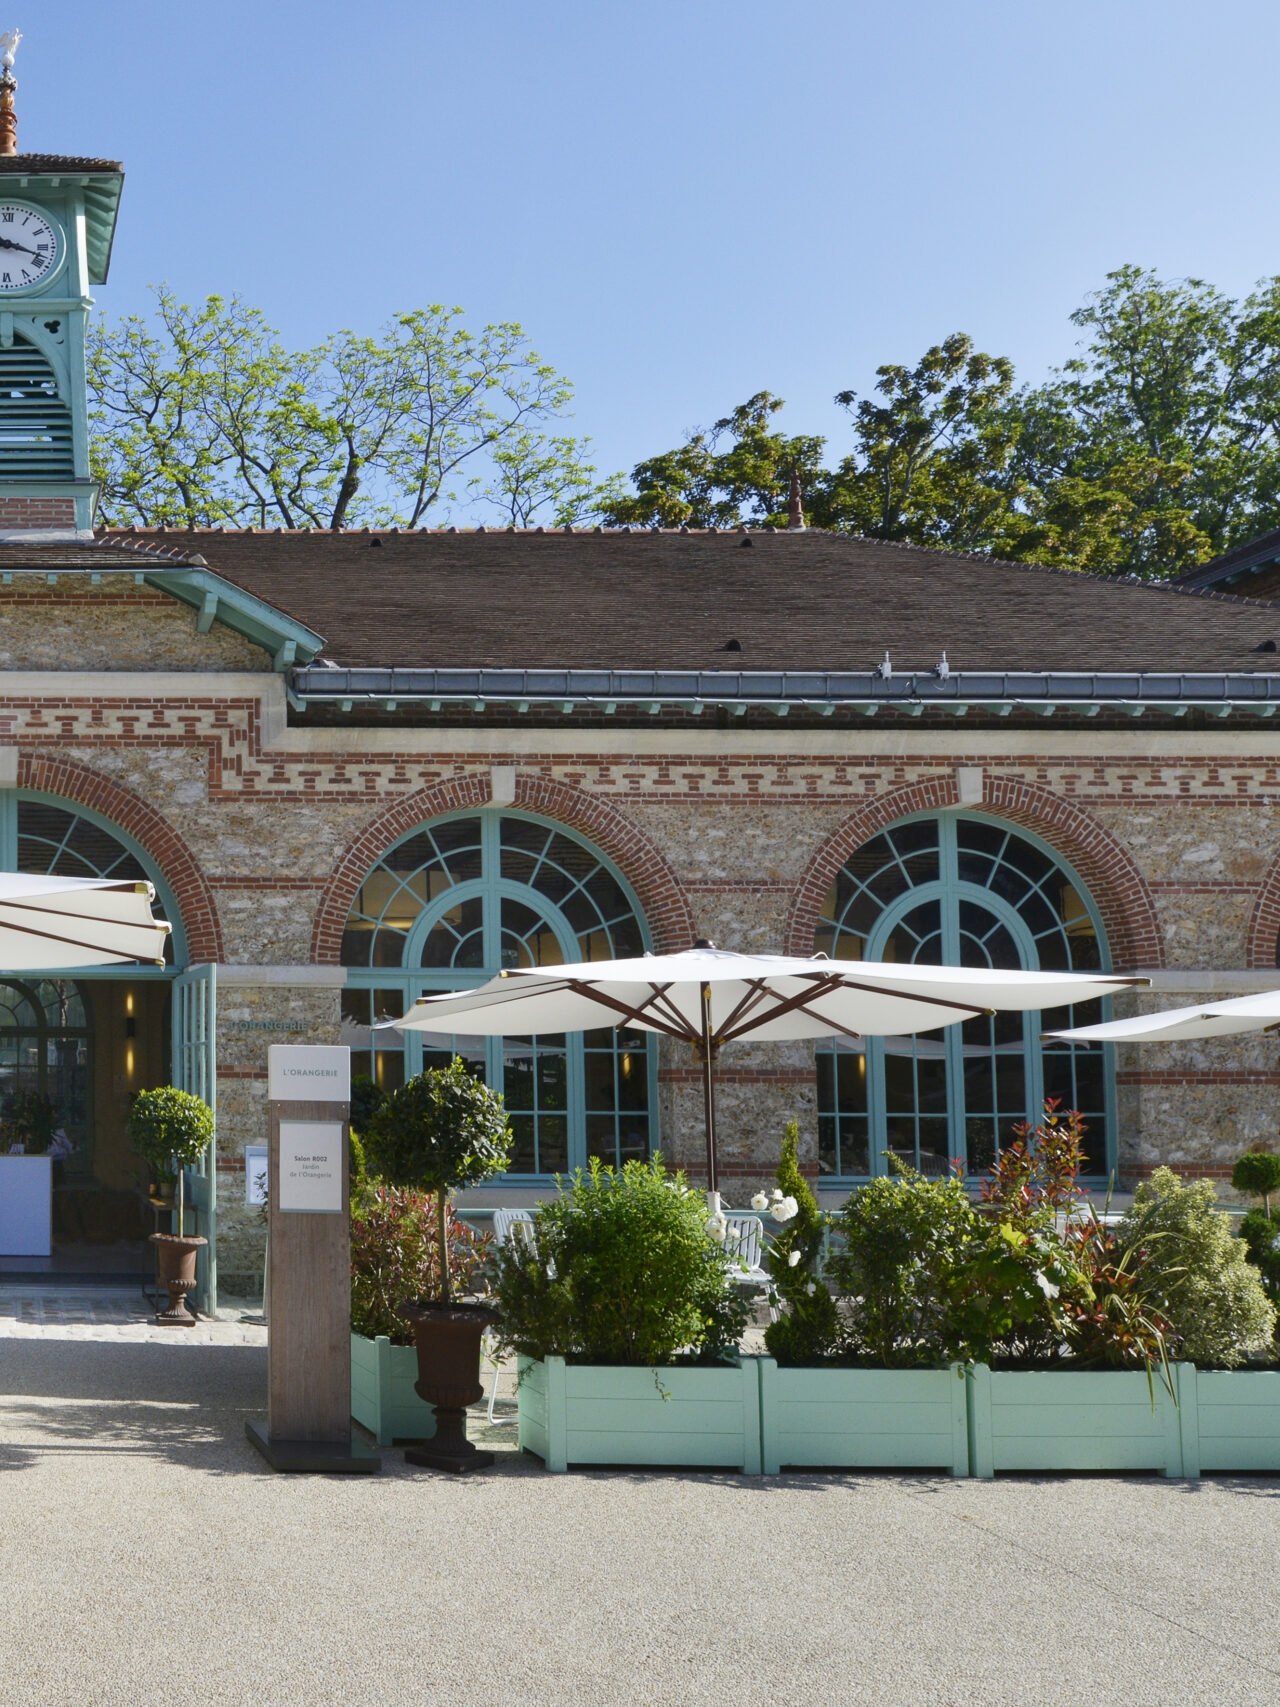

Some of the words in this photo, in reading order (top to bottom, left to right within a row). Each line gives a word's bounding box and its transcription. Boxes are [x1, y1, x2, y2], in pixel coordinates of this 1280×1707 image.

[1, 213, 14, 222] XII
[22, 217, 29, 226] I
[32, 228, 44, 236] II
[2, 272, 12, 283] VI
[21, 269, 30, 279] V
[283, 1069, 338, 1077] L'ORANGERIE
